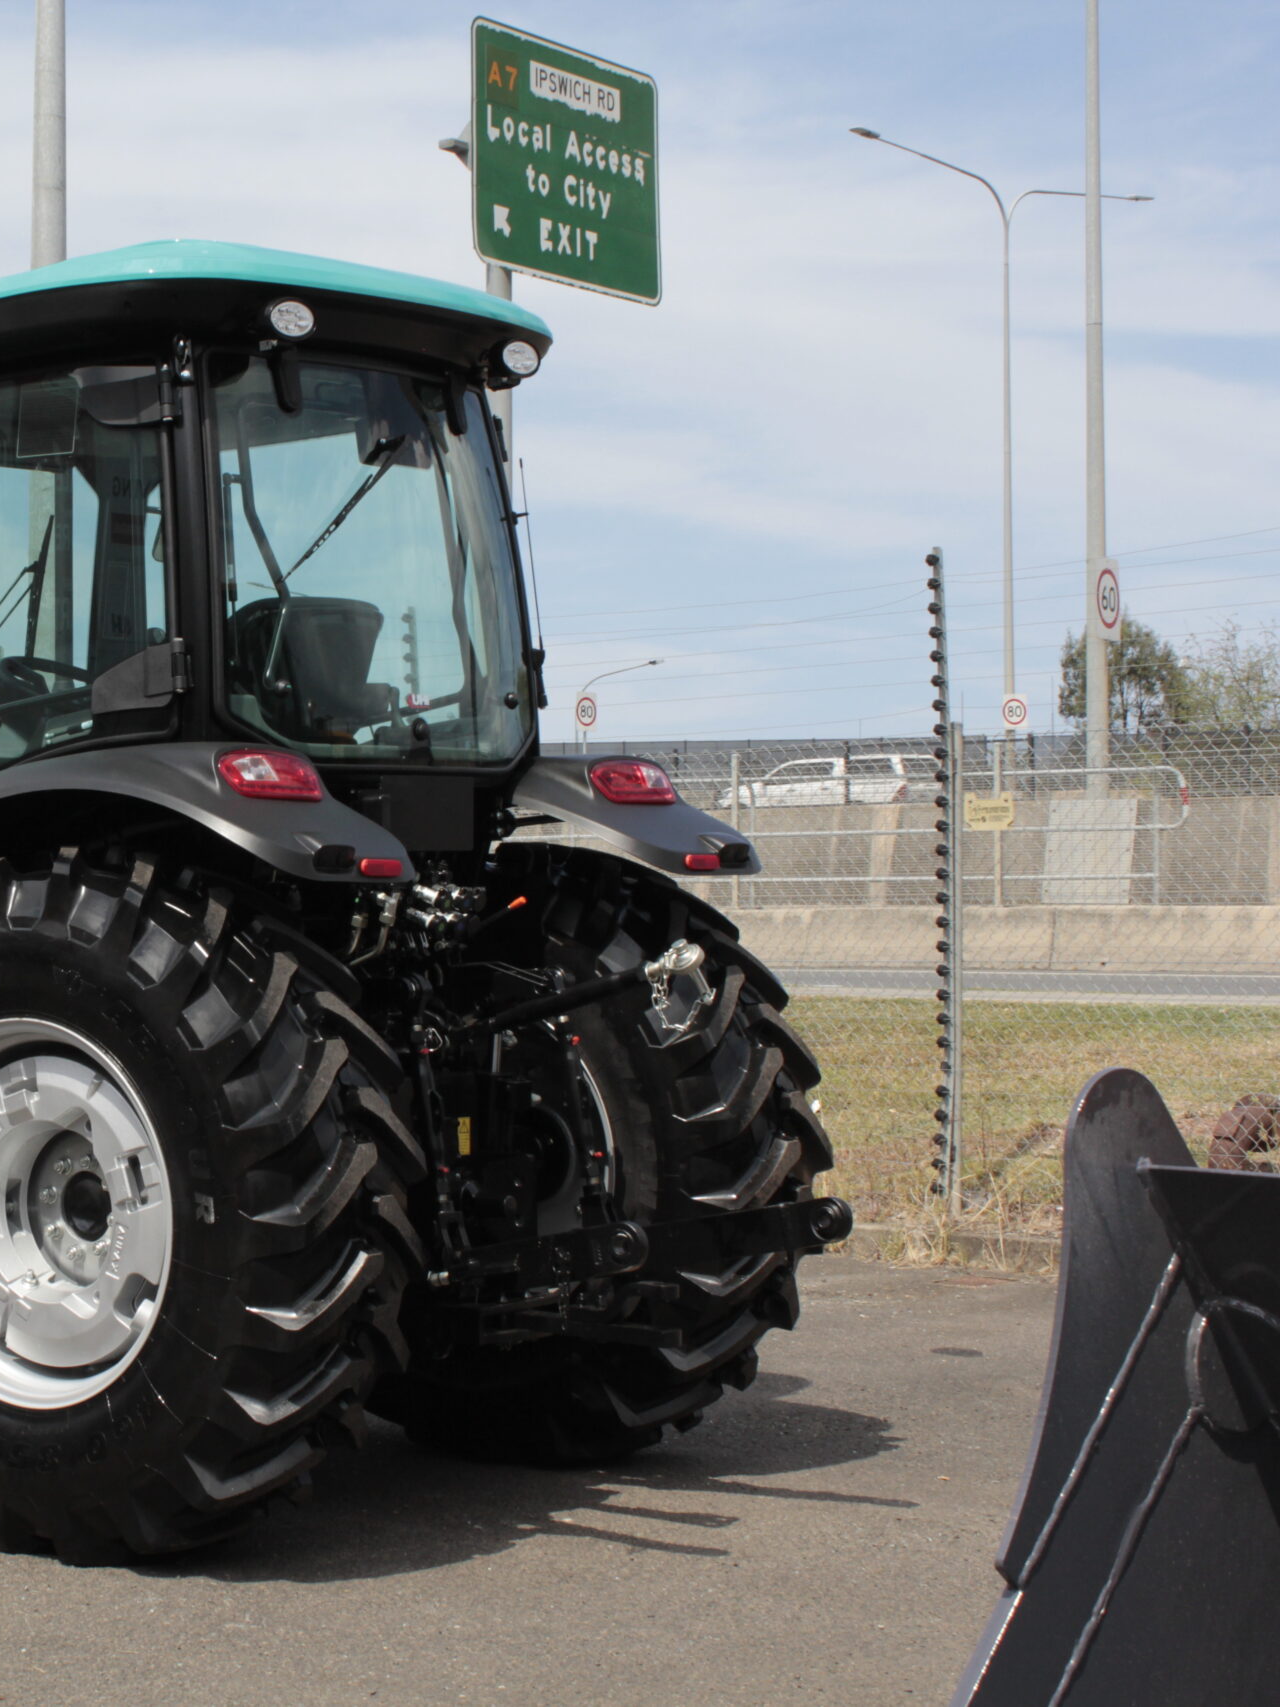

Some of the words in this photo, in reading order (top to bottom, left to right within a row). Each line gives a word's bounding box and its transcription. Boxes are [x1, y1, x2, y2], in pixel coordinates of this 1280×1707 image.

[488, 61, 517, 91] A7
[535, 68, 591, 104] IPSWICH
[598, 92, 615, 112] RD
[487, 104, 551, 152] Local
[565, 130, 645, 185] Access
[526, 164, 550, 197] to
[564, 175, 611, 219] City
[540, 217, 598, 260] EXIT
[1102, 586, 1116, 612] 60
[580, 704, 593, 718] 80
[1007, 705, 1023, 718] 80
